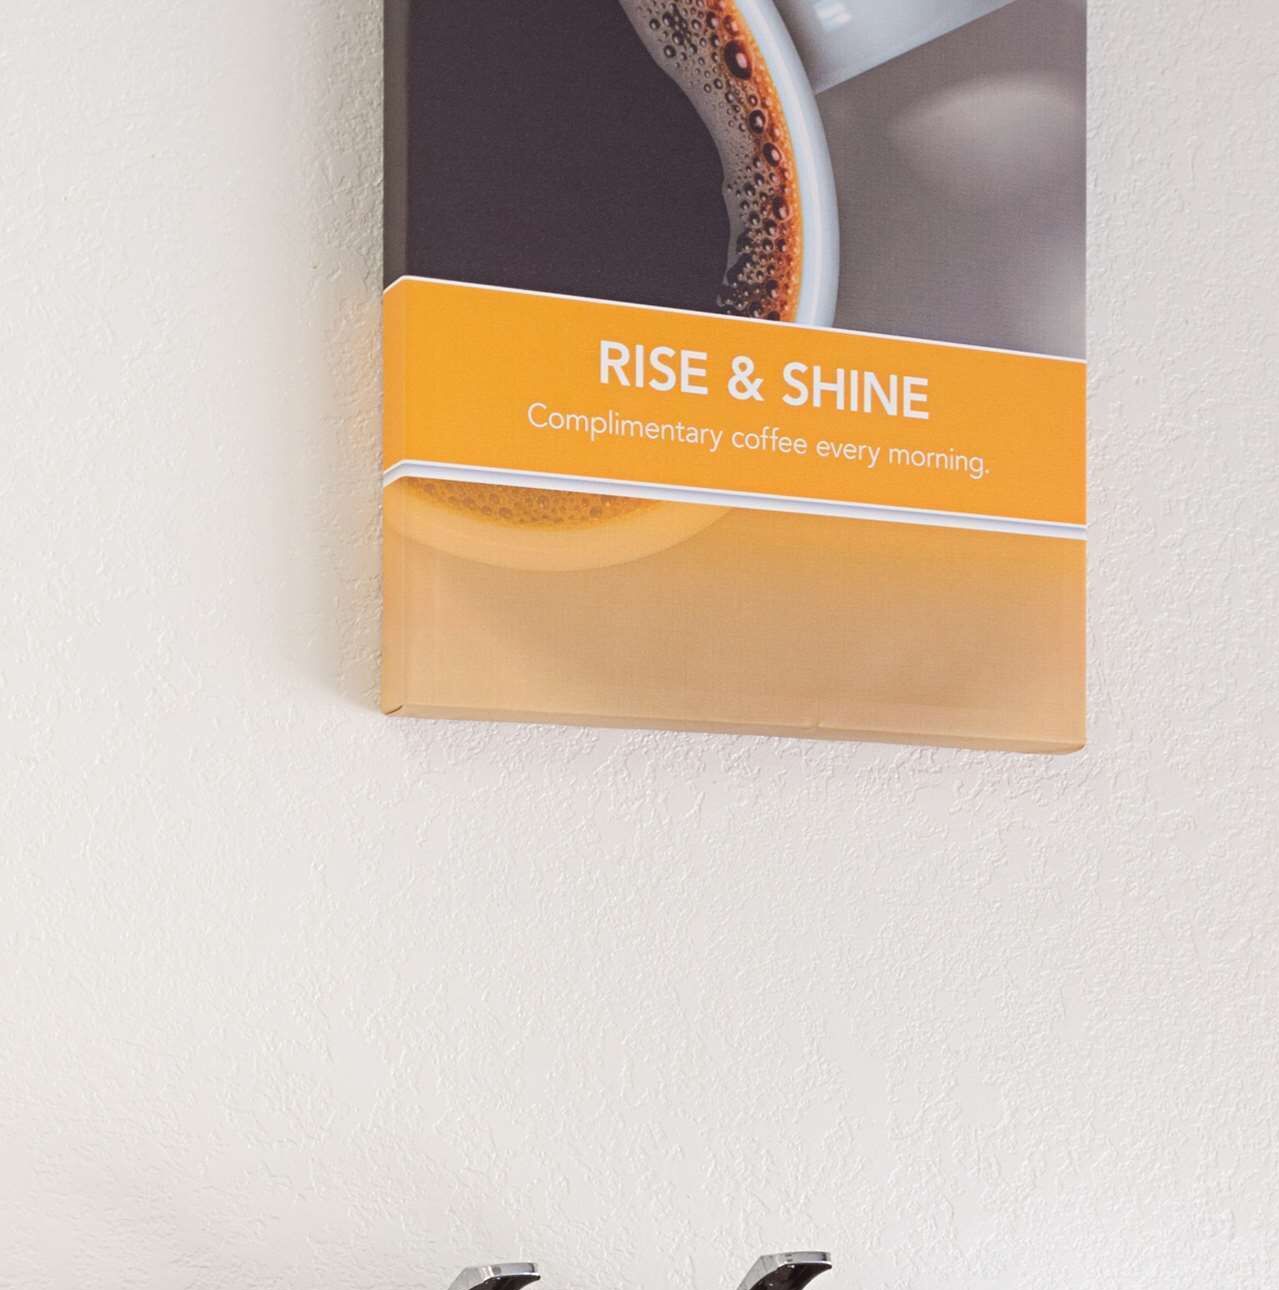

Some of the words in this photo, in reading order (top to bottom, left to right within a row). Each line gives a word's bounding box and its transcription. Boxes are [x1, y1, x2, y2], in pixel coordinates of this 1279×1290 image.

[600, 340, 708, 395] RISE
[727, 355, 764, 401] &
[782, 361, 929, 420] SHINE
[528, 402, 723, 452] Complimentary
[731, 426, 808, 454] coffee
[816, 440, 880, 468] every
[888, 447, 990, 480] morning.
